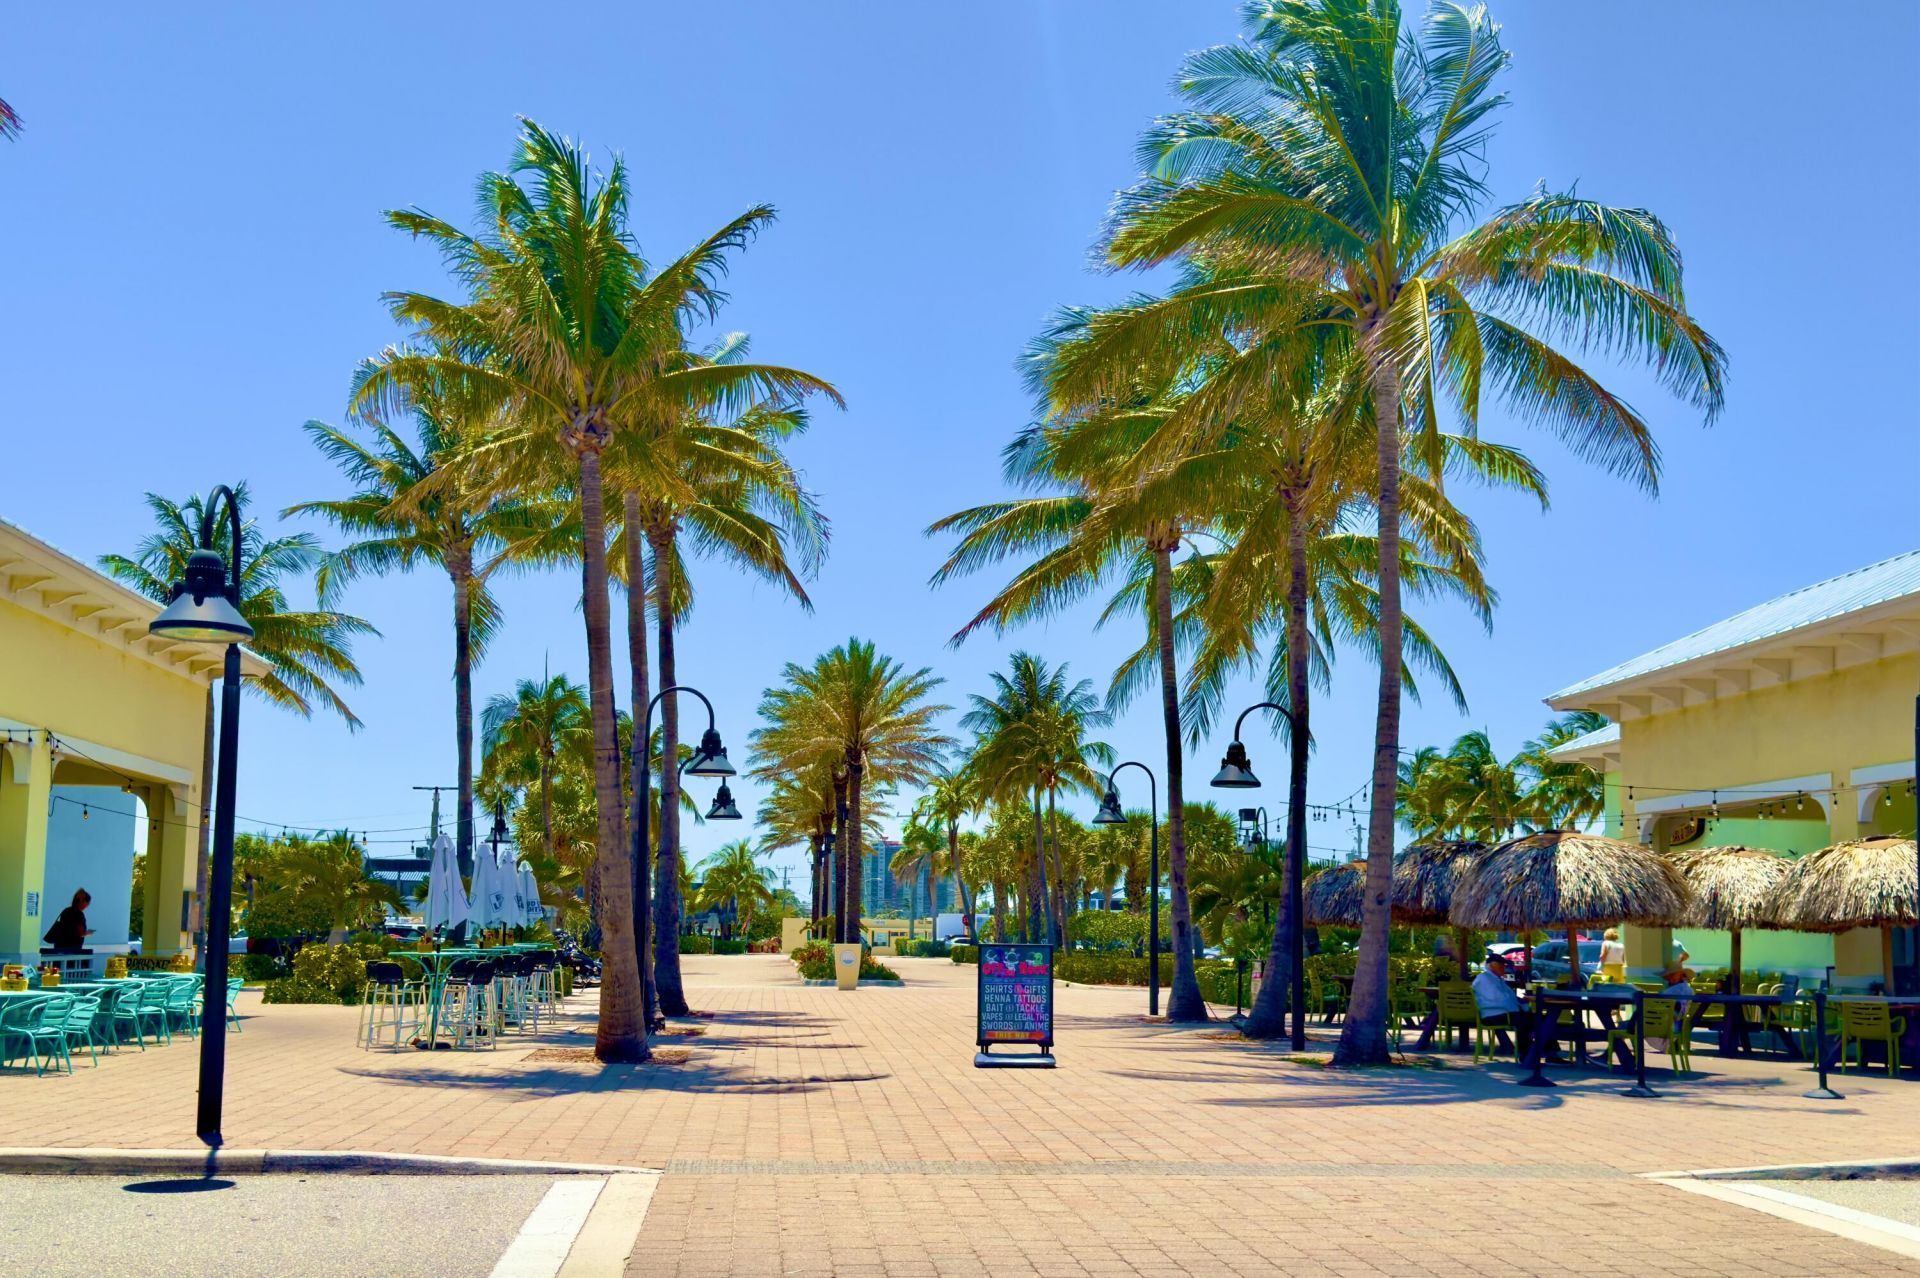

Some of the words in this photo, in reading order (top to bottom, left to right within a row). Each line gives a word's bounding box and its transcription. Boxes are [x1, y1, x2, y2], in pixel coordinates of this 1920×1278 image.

[984, 985, 1013, 994] SHIRTS
[1024, 985, 1047, 994] GIFTS
[984, 994, 1011, 1003] HENNA
[1013, 995, 1047, 1003] TATTOOS
[986, 1003, 1004, 1012] BAIT
[1016, 1004, 1045, 1012] TACKLE
[981, 1012, 1003, 1020] VAPES
[1014, 1013, 1034, 1021] LEGAL
[1035, 1013, 1050, 1021] THC
[982, 1021, 1013, 1030] SWORDS
[1024, 1022, 1049, 1031] ANIME
